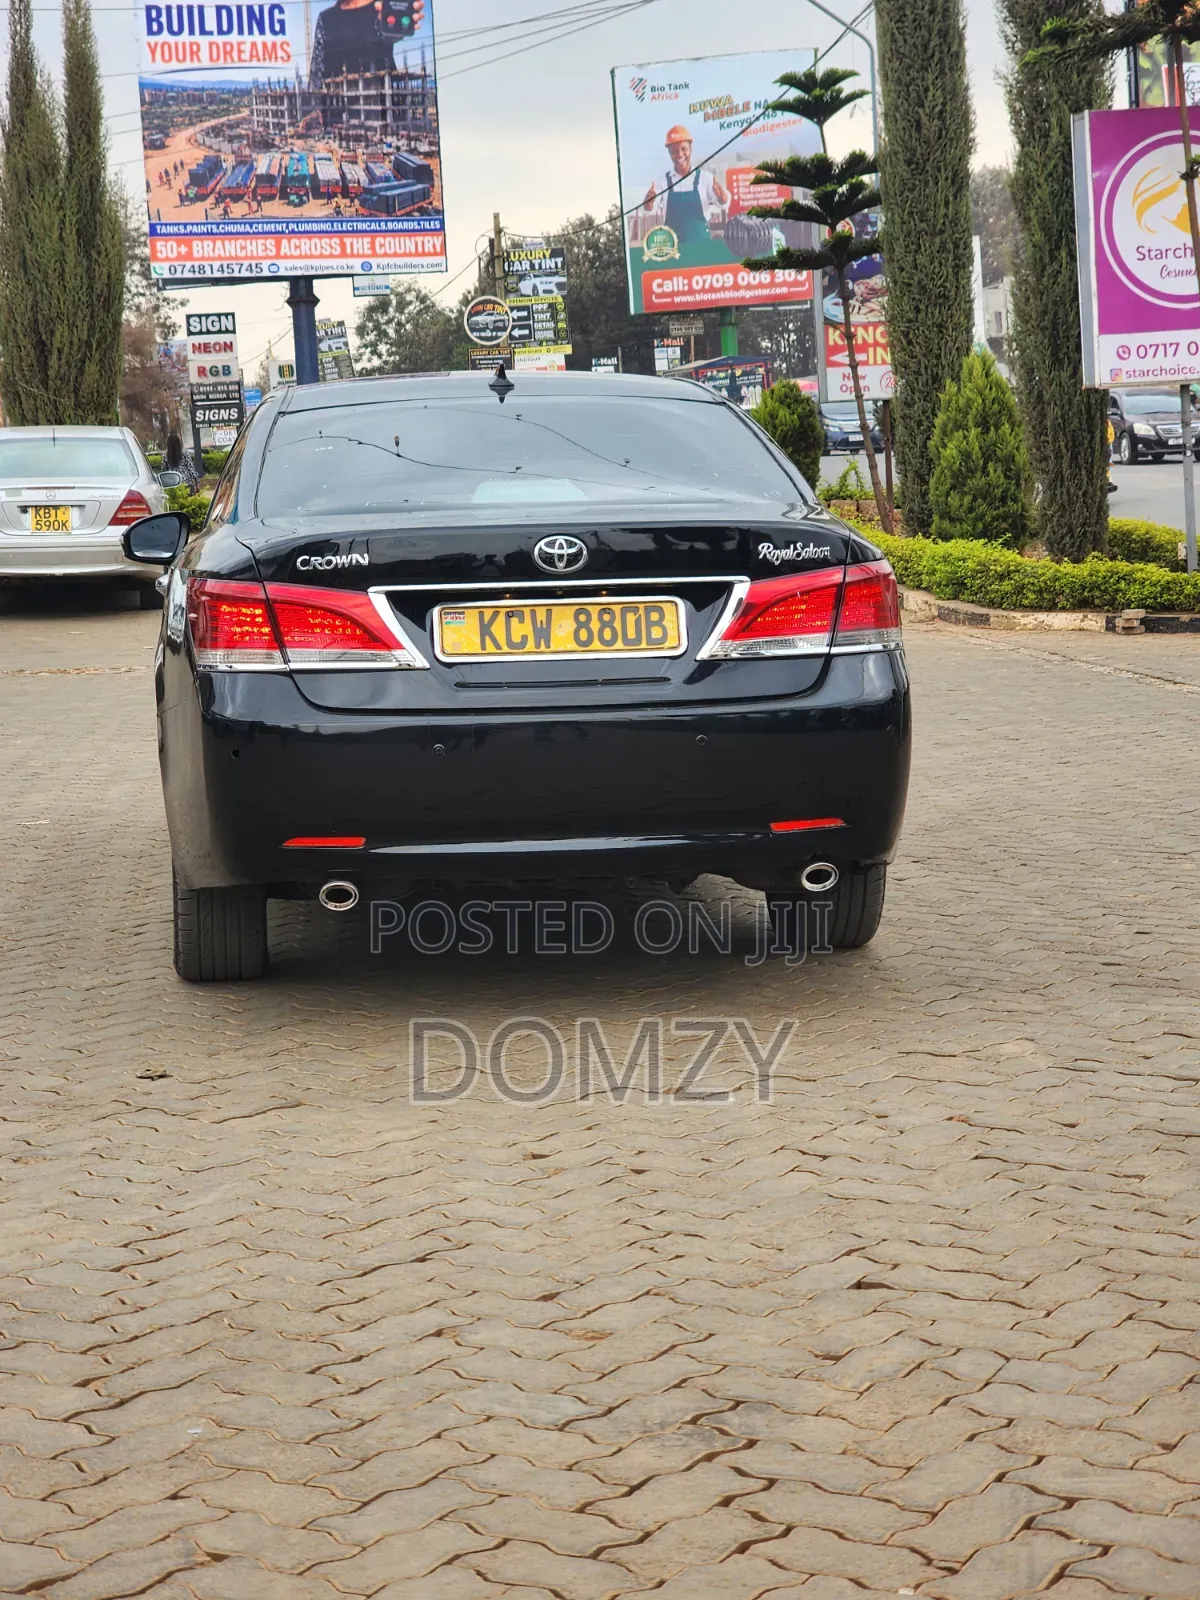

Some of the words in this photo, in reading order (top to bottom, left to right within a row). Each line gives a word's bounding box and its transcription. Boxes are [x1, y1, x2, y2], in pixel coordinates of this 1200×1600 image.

[145, 3, 287, 36] BUILDING
[146, 40, 203, 64] YOUR
[208, 40, 292, 64] DREAMS
[650, 84, 666, 93] Bio
[667, 81, 690, 92] Tank
[651, 92, 680, 101] Africa
[689, 94, 734, 115] KUWA
[703, 101, 751, 123] MBELE
[719, 113, 760, 131] Kenya'
[156, 240, 189, 259] 50+
[192, 238, 277, 258] BRANCHES
[280, 237, 341, 257] ACROSS
[343, 236, 372, 255] THE
[375, 235, 443, 254] COUNTRY
[168, 262, 263, 276] 0748145745
[532, 257, 564, 269] TINT
[652, 276, 689, 293] Call:
[692, 272, 734, 290] 0709
[534, 312, 551, 320] TINT
[189, 315, 233, 333] SIGN
[191, 341, 234, 354] NEON
[1136, 342, 1180, 360] 0717
[592, 357, 618, 366] K-Mall
[197, 364, 232, 378] RGB
[840, 384, 870, 395] Opn
[195, 408, 239, 422] SIGNS
[34, 506, 60, 519] KBT
[34, 520, 69, 531] 590K
[296, 553, 369, 570] CROWN
[478, 607, 552, 651] KCW
[574, 604, 669, 648] 880B
